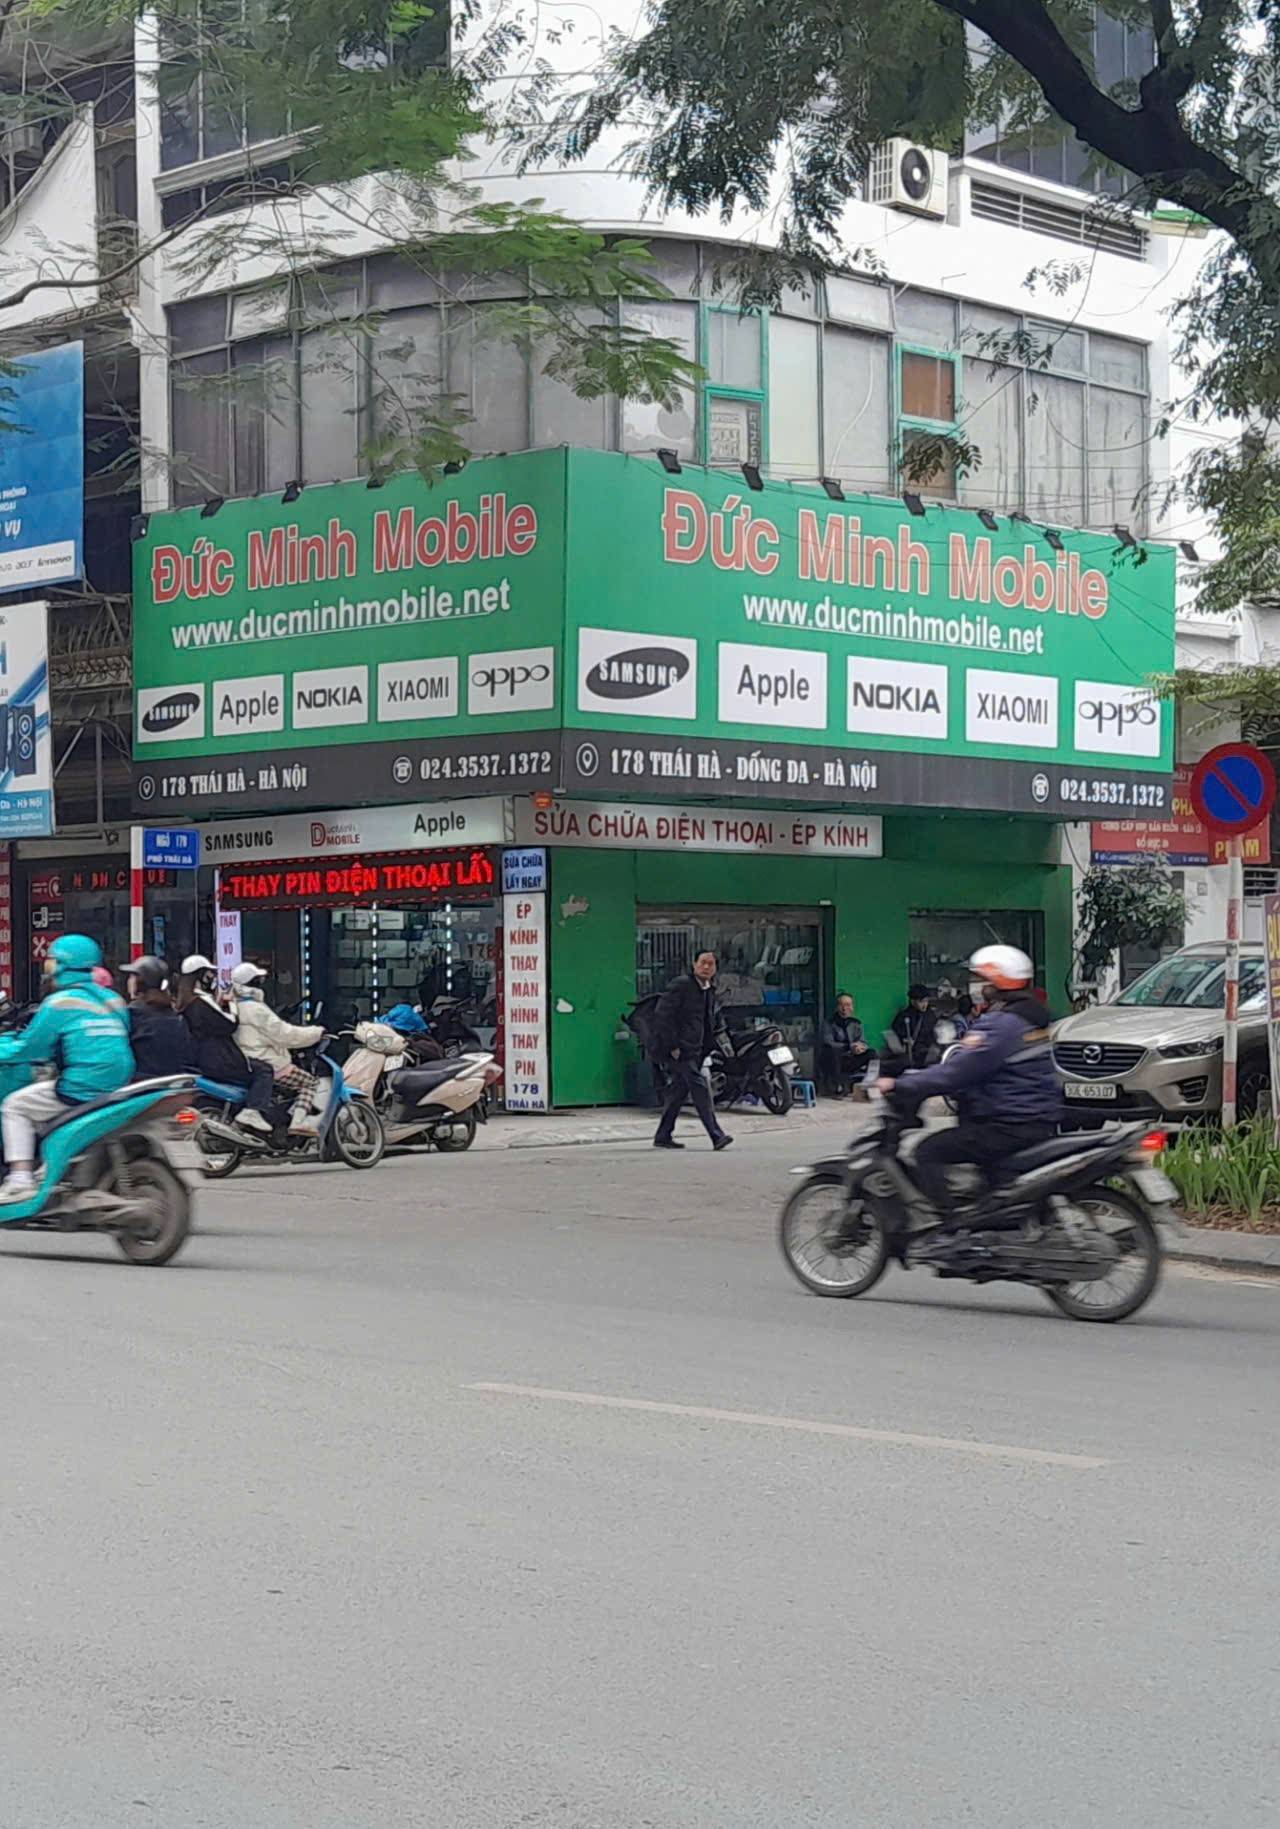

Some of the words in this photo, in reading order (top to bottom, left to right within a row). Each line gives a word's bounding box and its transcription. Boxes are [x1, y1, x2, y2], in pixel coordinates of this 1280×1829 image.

[4, 518, 21, 540] VỤ
[151, 537, 234, 604] Đức
[247, 518, 357, 591] Minh
[373, 493, 537, 574] Mobile
[661, 487, 780, 575] Đức
[797, 508, 930, 596] Minh
[948, 532, 1109, 619] Mobile
[172, 578, 512, 649] www.ducminhmobile.net
[743, 594, 1044, 654] www.ducminhmobile.net
[599, 660, 679, 688] SAMSUNG
[737, 664, 810, 706] Apple
[297, 686, 363, 710] NOKIA
[388, 675, 450, 702] XIAOMI
[853, 681, 941, 714] NOKIA
[219, 690, 280, 725] Apple
[977, 692, 1048, 725] XIAOMI
[421, 751, 552, 780] 024.3537.1372
[611, 749, 644, 774] 178
[650, 747, 692, 777] THÁI
[698, 750, 721, 779] HÀ
[824, 760, 846, 788] HÀ
[850, 760, 877, 791] NỘI
[162, 776, 186, 797] 178
[189, 770, 222, 795] THÁI
[227, 768, 245, 793] HÀ
[258, 765, 278, 790] HÀ
[282, 763, 307, 791] NỘI
[1060, 778, 1165, 808] 024.3537.1372
[414, 811, 466, 837] Apple
[535, 803, 580, 836] SỬA
[589, 809, 649, 839] CHỮA
[656, 812, 705, 846] ĐIỆN
[712, 820, 773, 849] THOẠI
[792, 818, 817, 846] ÉP
[824, 819, 869, 848] KÍNH
[205, 830, 274, 851] SAMSUNG
[504, 853, 520, 869] SỬA
[521, 852, 543, 868] CHỮA
[285, 870, 321, 895] PIN
[326, 862, 377, 896] ĐIỆN
[382, 861, 452, 892] THOẠI
[505, 873, 520, 890] LẤY
[521, 875, 542, 889] NGAY
[219, 914, 237, 929] THAY
[517, 899, 532, 919] ÉP
[510, 926, 538, 945] KÍNH
[510, 955, 539, 971] THAY
[511, 979, 539, 998] MÀN
[510, 1004, 539, 1024] HÌNH
[511, 1034, 540, 1049] THAY
[515, 1060, 536, 1076] PIN
[513, 1083, 539, 1095] 178
[508, 1097, 529, 1109] THÁI
